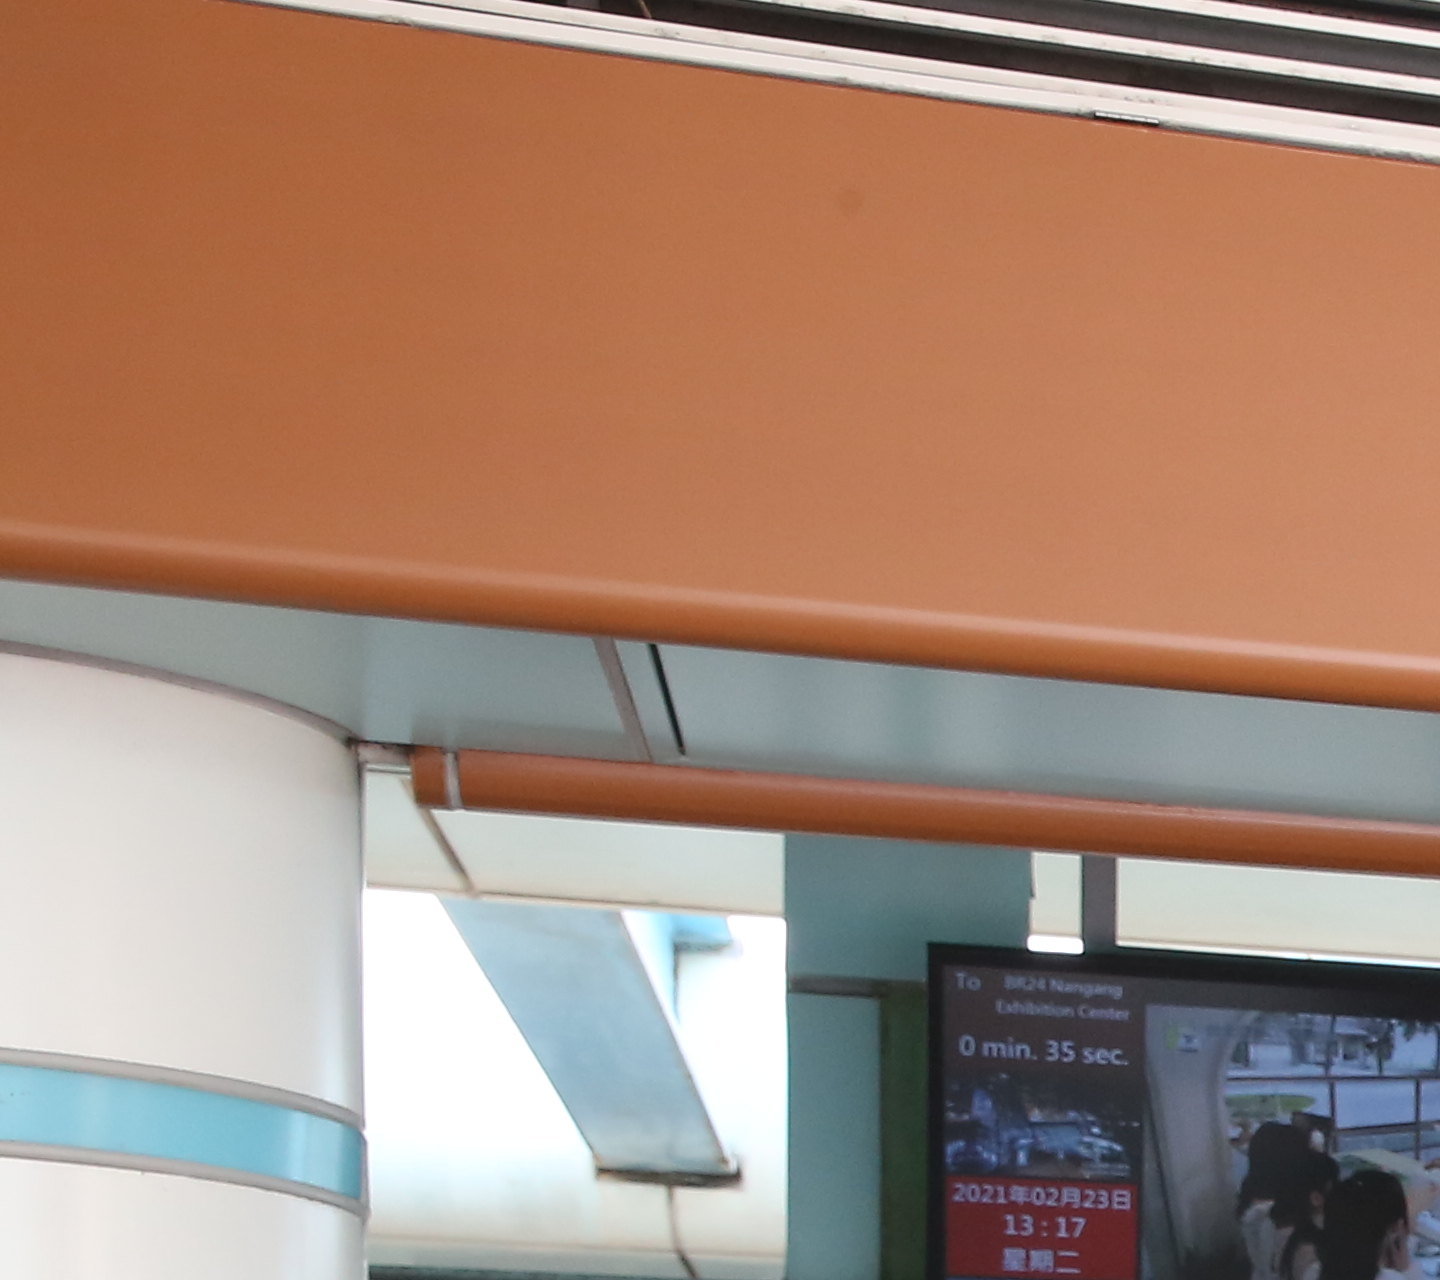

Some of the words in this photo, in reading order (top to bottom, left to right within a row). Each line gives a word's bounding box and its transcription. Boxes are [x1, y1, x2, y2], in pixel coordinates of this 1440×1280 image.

[955, 971, 982, 991] To
[958, 1035, 976, 1057] 0
[982, 1037, 1038, 1061] min.
[1046, 1040, 1077, 1063] 35
[1082, 1048, 1130, 1067] sec.
[952, 1183, 1132, 1211] 2021年02月23日
[1003, 1248, 1081, 1275] 星期二
